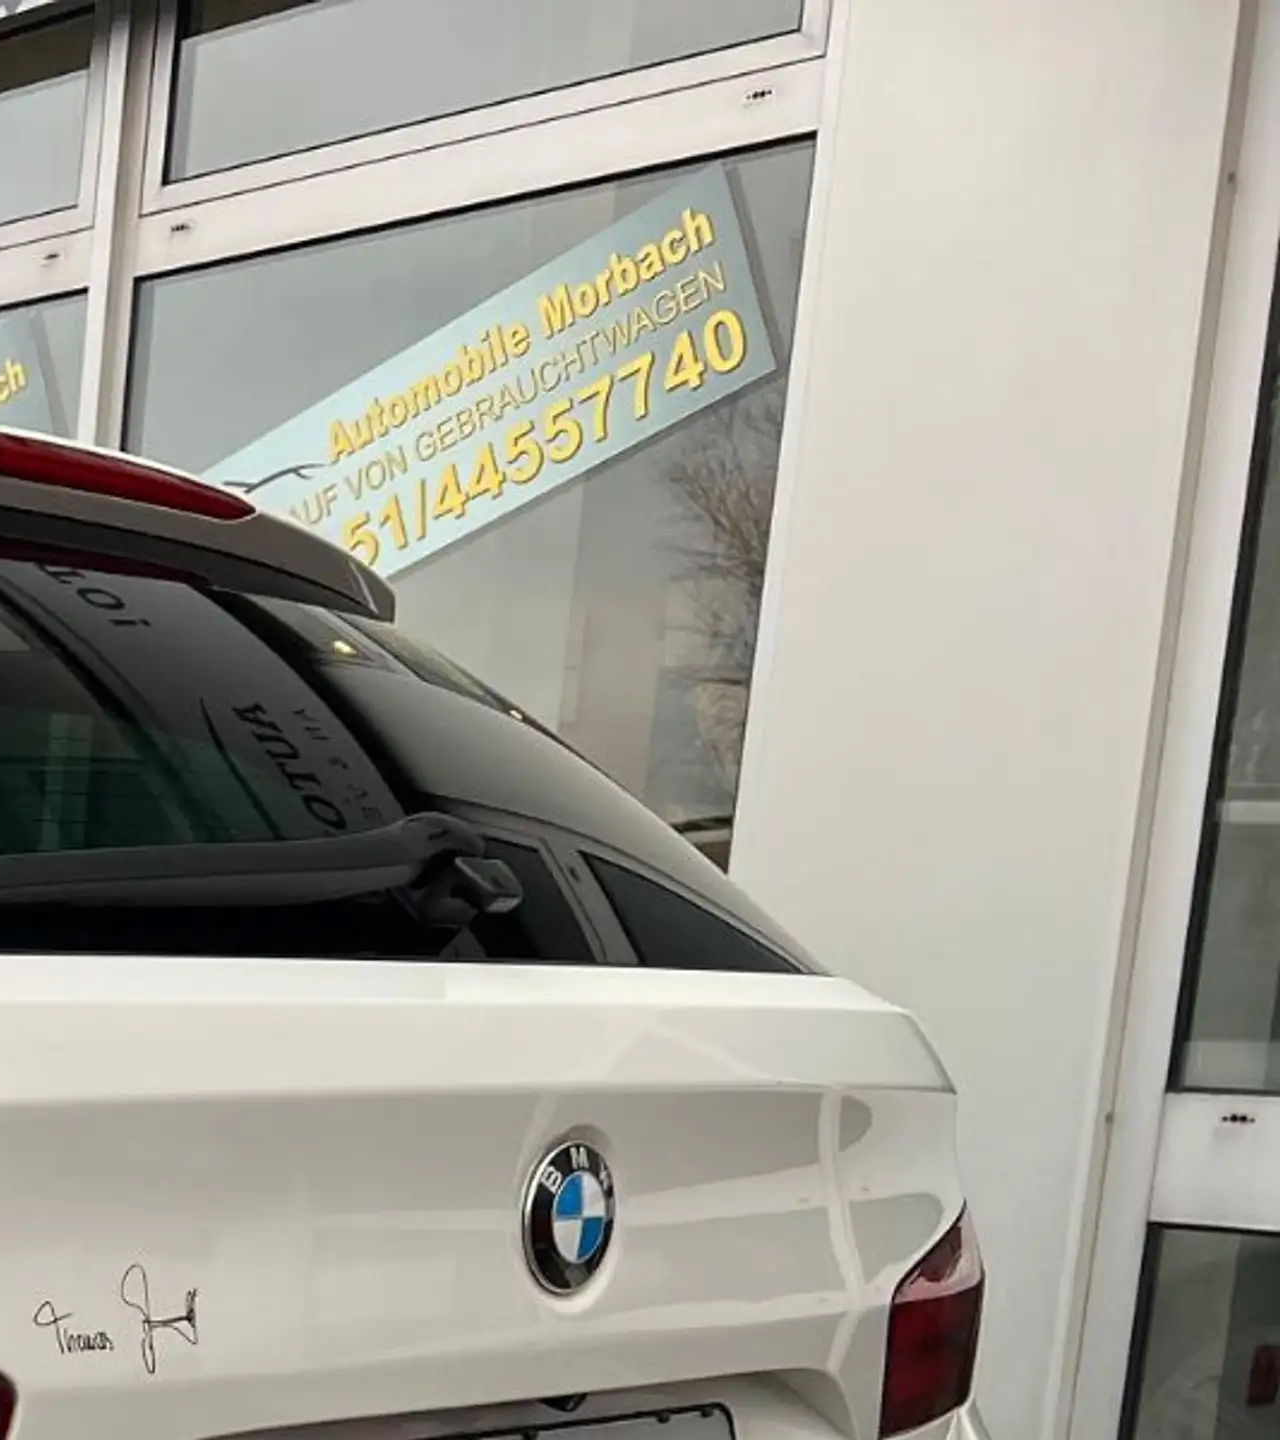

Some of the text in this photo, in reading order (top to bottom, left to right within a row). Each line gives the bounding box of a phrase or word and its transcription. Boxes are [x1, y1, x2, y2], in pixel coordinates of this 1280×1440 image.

[326, 207, 715, 465] Automobile Morbach
[343, 308, 748, 567] 51/44557740
[344, 445, 409, 501] VON
[414, 261, 727, 462] GEBRAUCHTWAGEN
